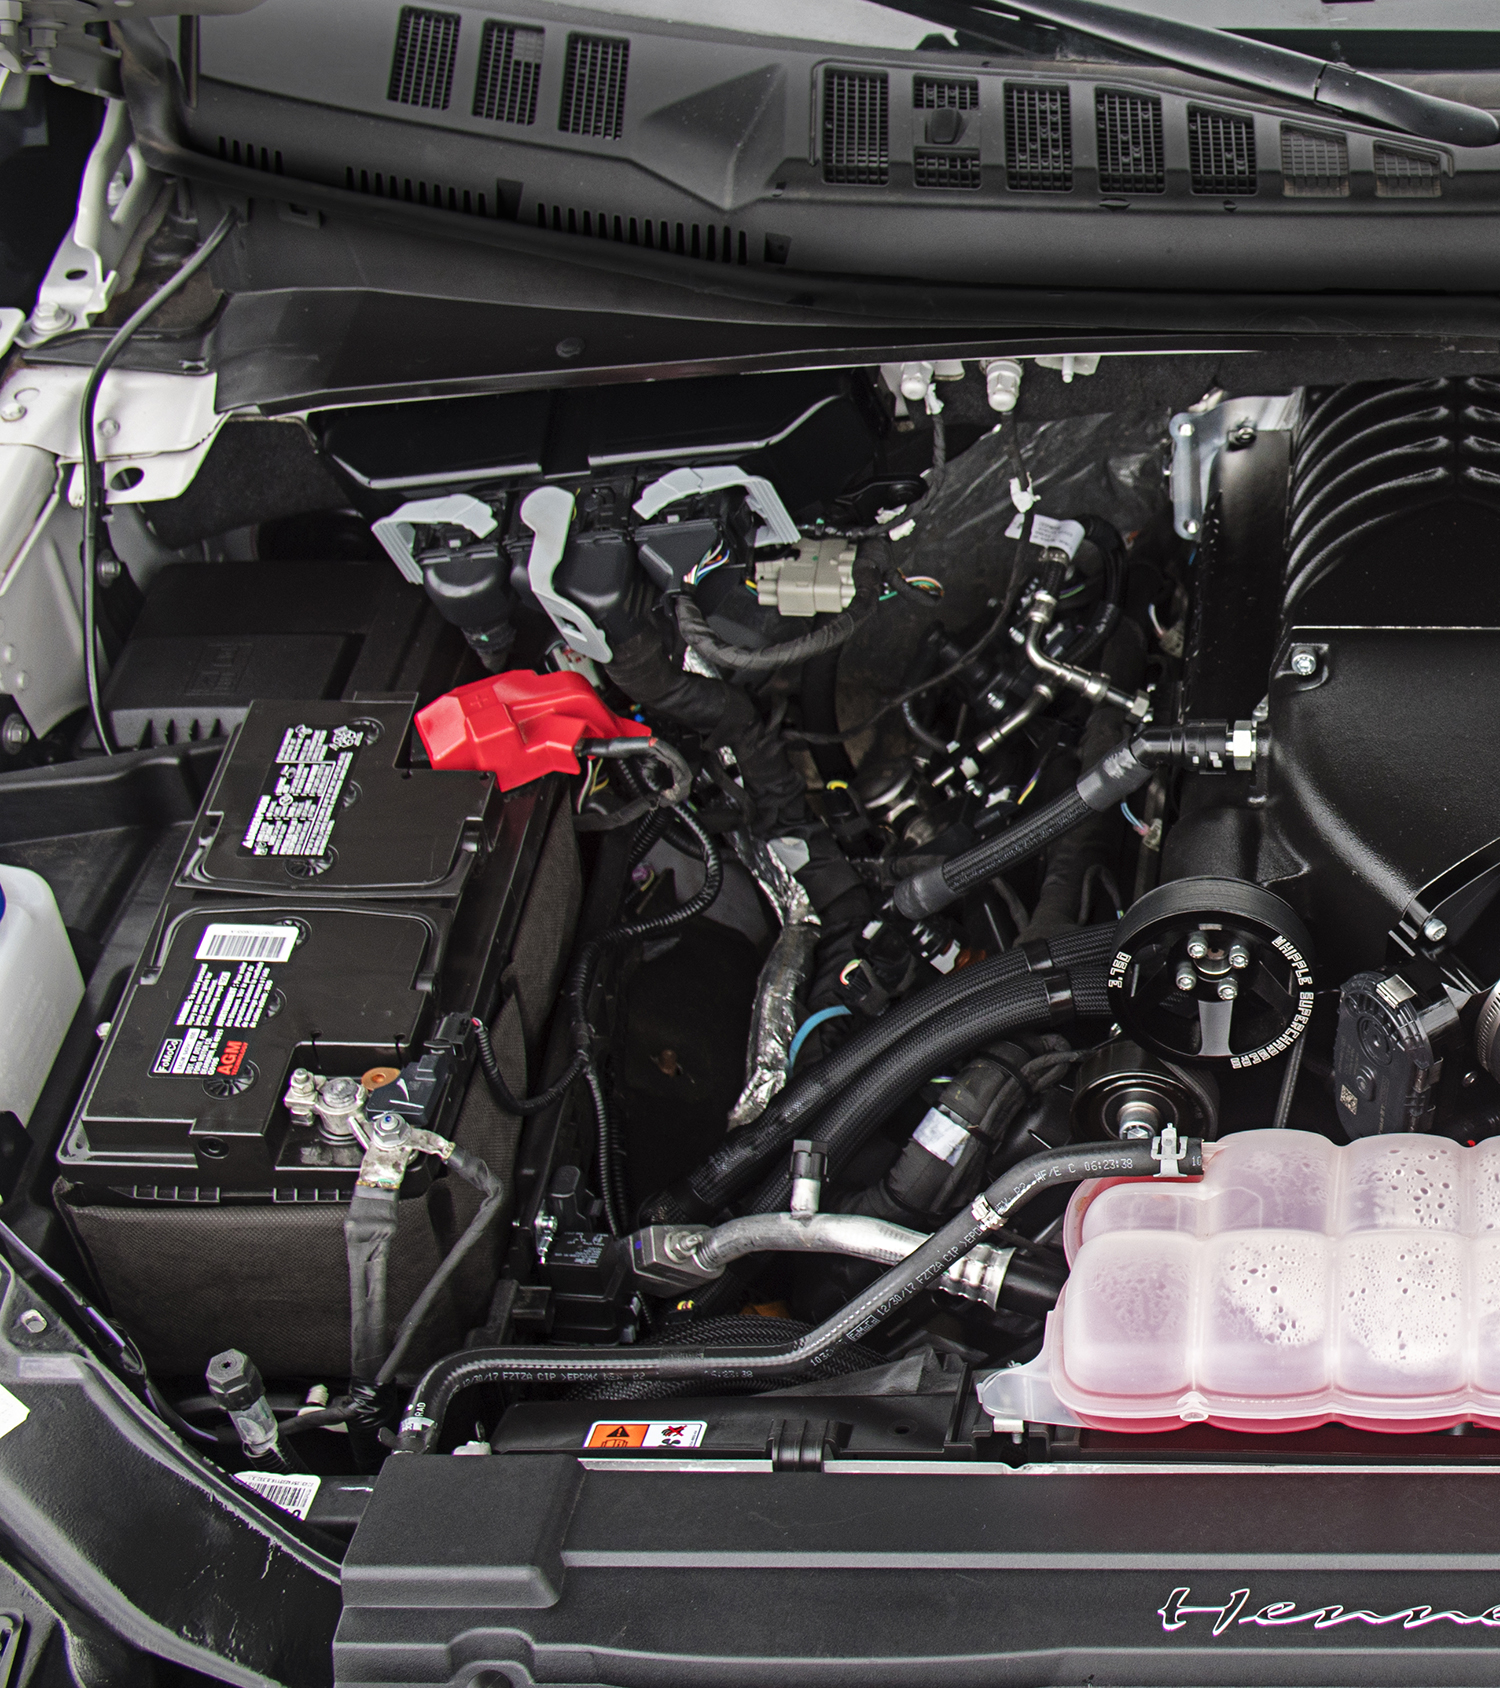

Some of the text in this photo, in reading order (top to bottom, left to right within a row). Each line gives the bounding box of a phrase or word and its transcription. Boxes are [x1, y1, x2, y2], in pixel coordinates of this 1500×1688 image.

[1230, 935, 1314, 1069] WHIPPLE SUPERCHARGERS
[217, 1040, 242, 1075] AGM
[231, 1042, 248, 1075] TECHNOLOGY
[876, 1281, 917, 1317] 12/30/17
[942, 1246, 960, 1263] CIP
[1068, 1163, 1077, 1174] C
[1084, 1157, 1134, 1172] 06:23:38
[536, 1373, 557, 1381] CIP
[414, 1401, 427, 1417] RAD
